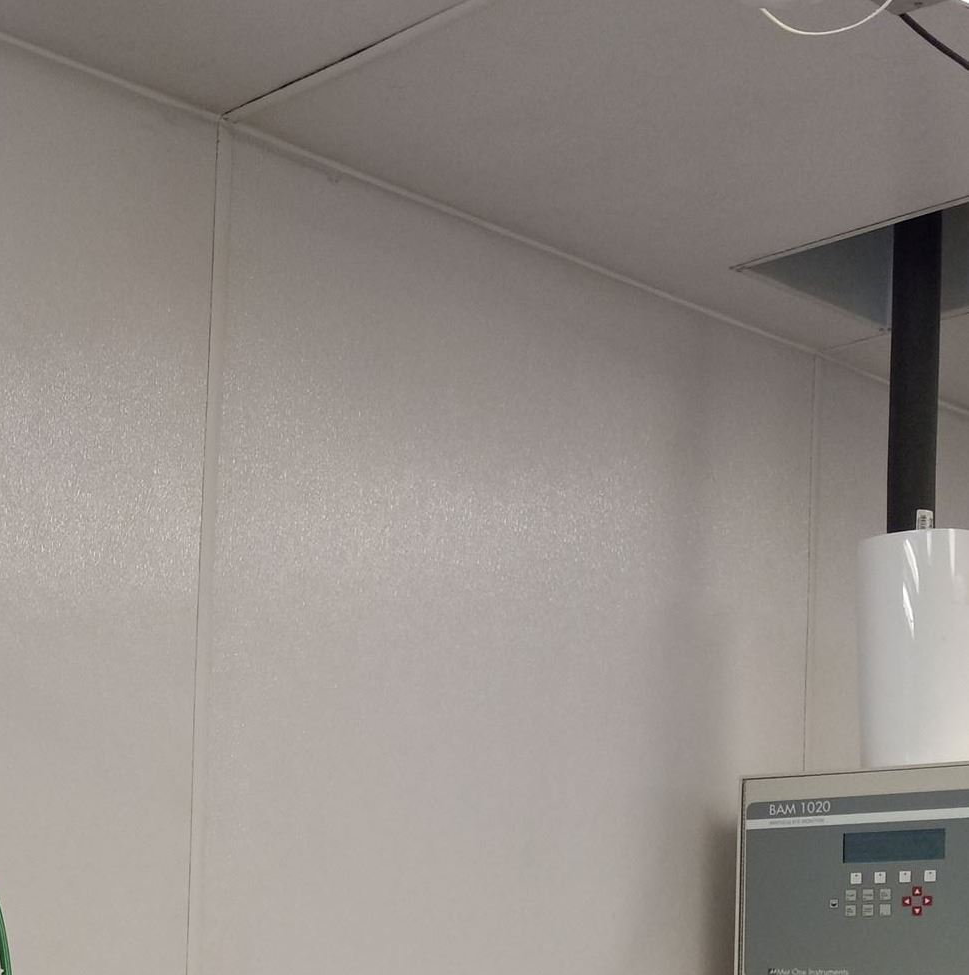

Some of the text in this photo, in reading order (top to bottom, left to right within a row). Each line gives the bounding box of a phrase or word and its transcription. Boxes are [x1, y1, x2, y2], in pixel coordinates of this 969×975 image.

[769, 800, 831, 816] BAM 1020
[791, 968, 806, 975] One
[808, 968, 849, 975] Instruments
